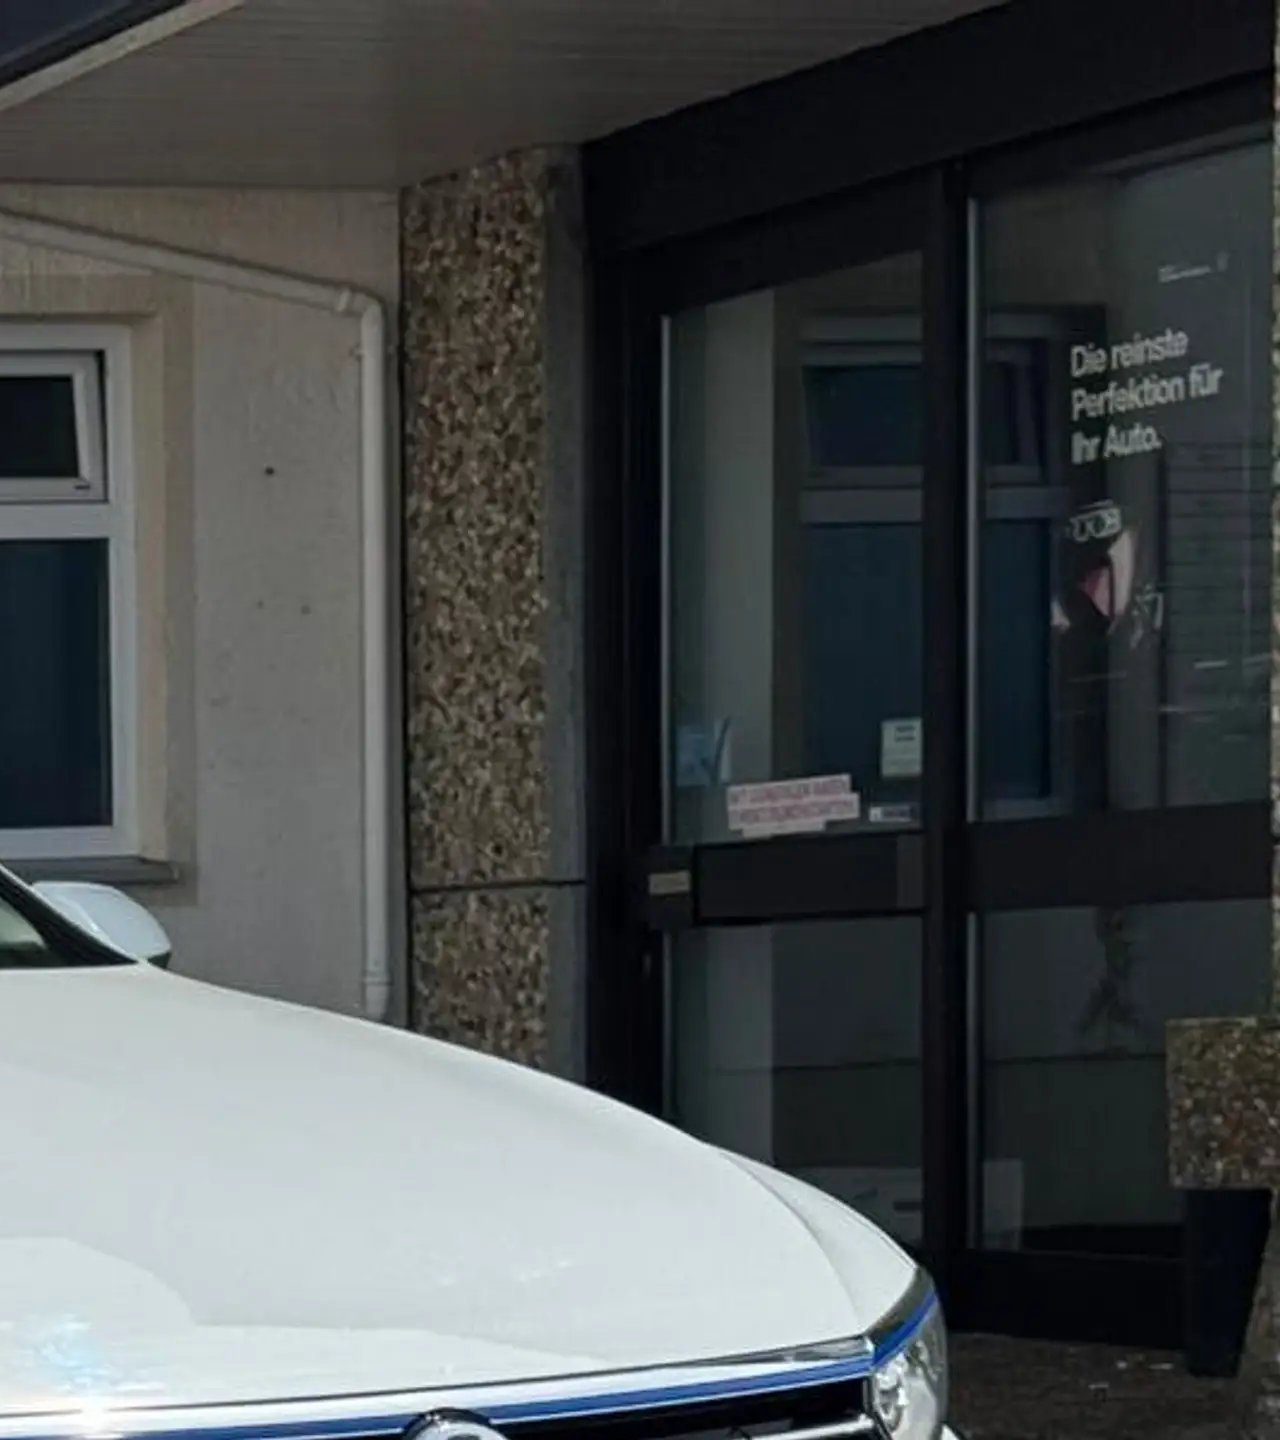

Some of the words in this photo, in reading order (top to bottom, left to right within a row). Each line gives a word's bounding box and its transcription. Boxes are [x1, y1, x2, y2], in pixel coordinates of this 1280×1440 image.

[1070, 344, 1107, 377] Die
[1111, 327, 1190, 370] reinste
[1071, 373, 1185, 421] Perfektion
[1188, 362, 1224, 398] für
[1071, 431, 1101, 464] Ihr
[1103, 421, 1162, 459] Auto.
